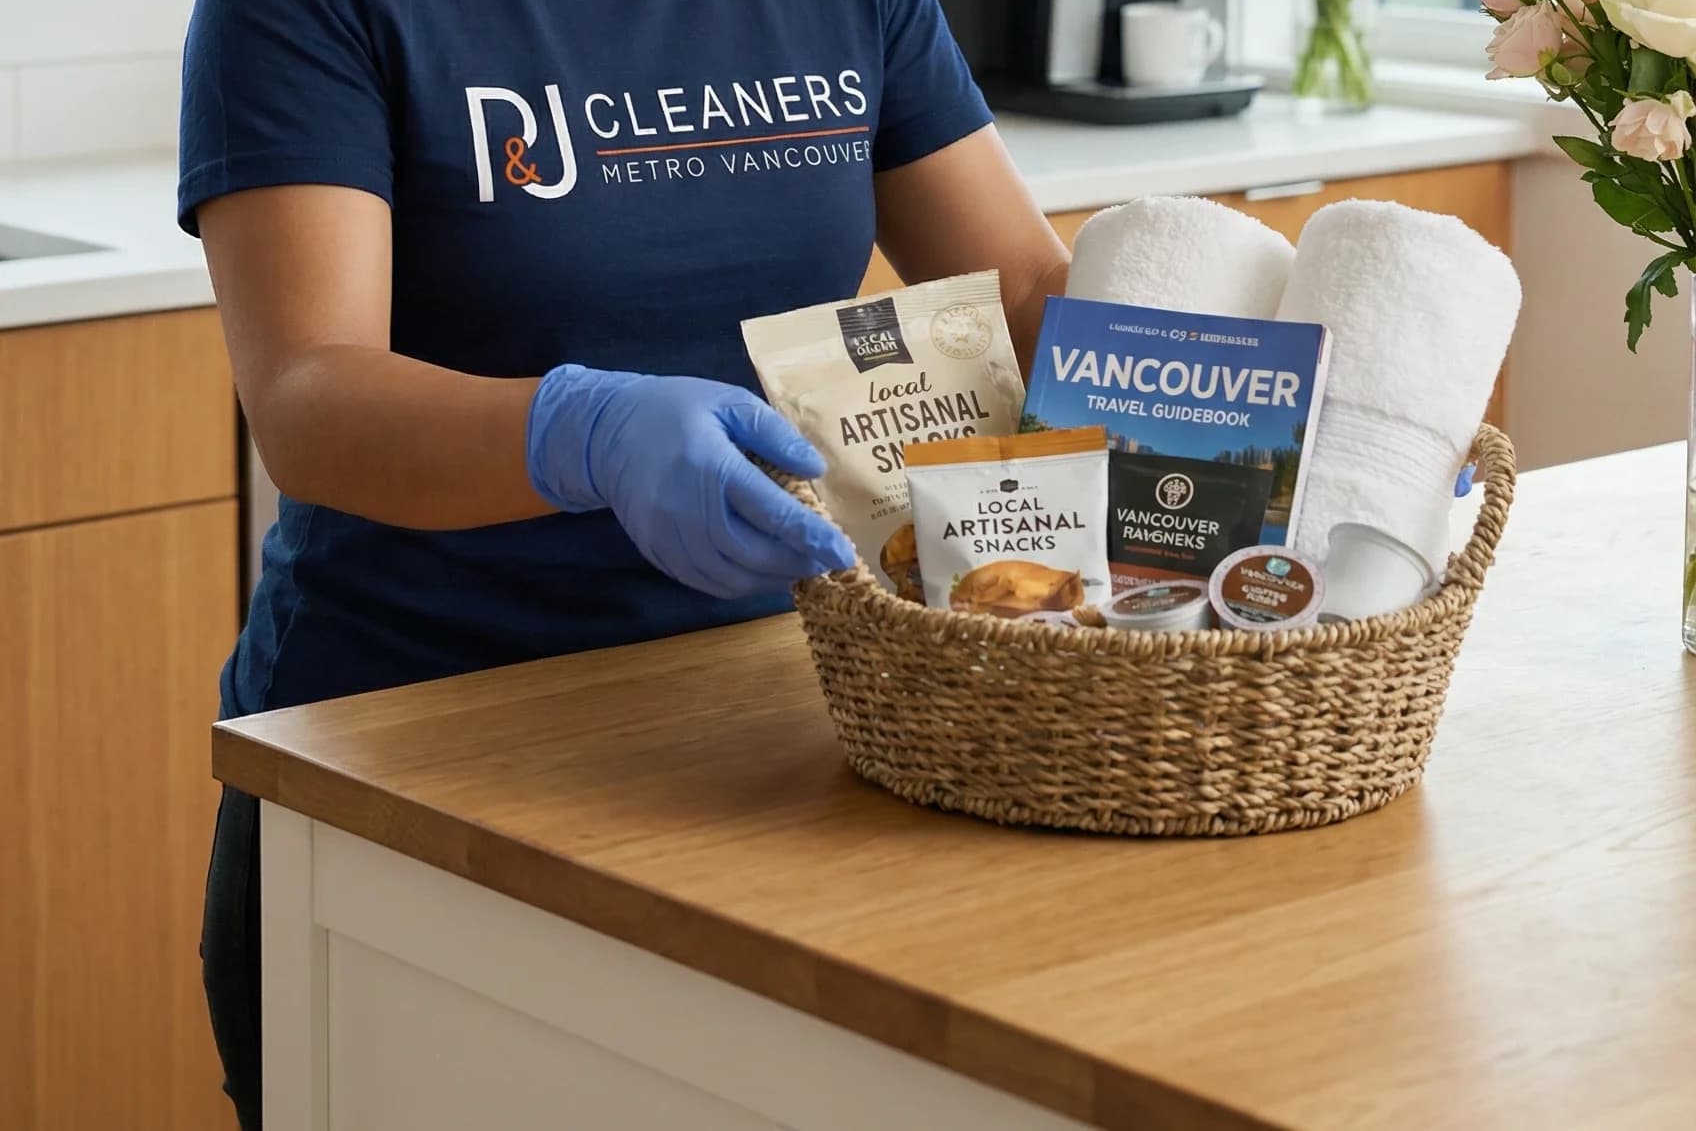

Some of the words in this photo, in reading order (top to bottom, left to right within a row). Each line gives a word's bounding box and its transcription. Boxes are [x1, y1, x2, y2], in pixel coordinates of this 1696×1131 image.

[585, 69, 867, 139] CLEANERS
[602, 156, 705, 184] METRO
[720, 140, 870, 172] VANCOUVER
[869, 371, 932, 403] local
[1051, 346, 1301, 408] VANCOUVER
[839, 390, 990, 446] ARTISANAL
[1086, 395, 1148, 417] TRAVEL
[1151, 403, 1251, 427] GUIDEBOOK
[978, 497, 1044, 515] LOCAL
[1117, 507, 1220, 536] VANCOUVER
[943, 511, 1086, 540] ARTISANAL
[973, 535, 1056, 553] SNACKS
